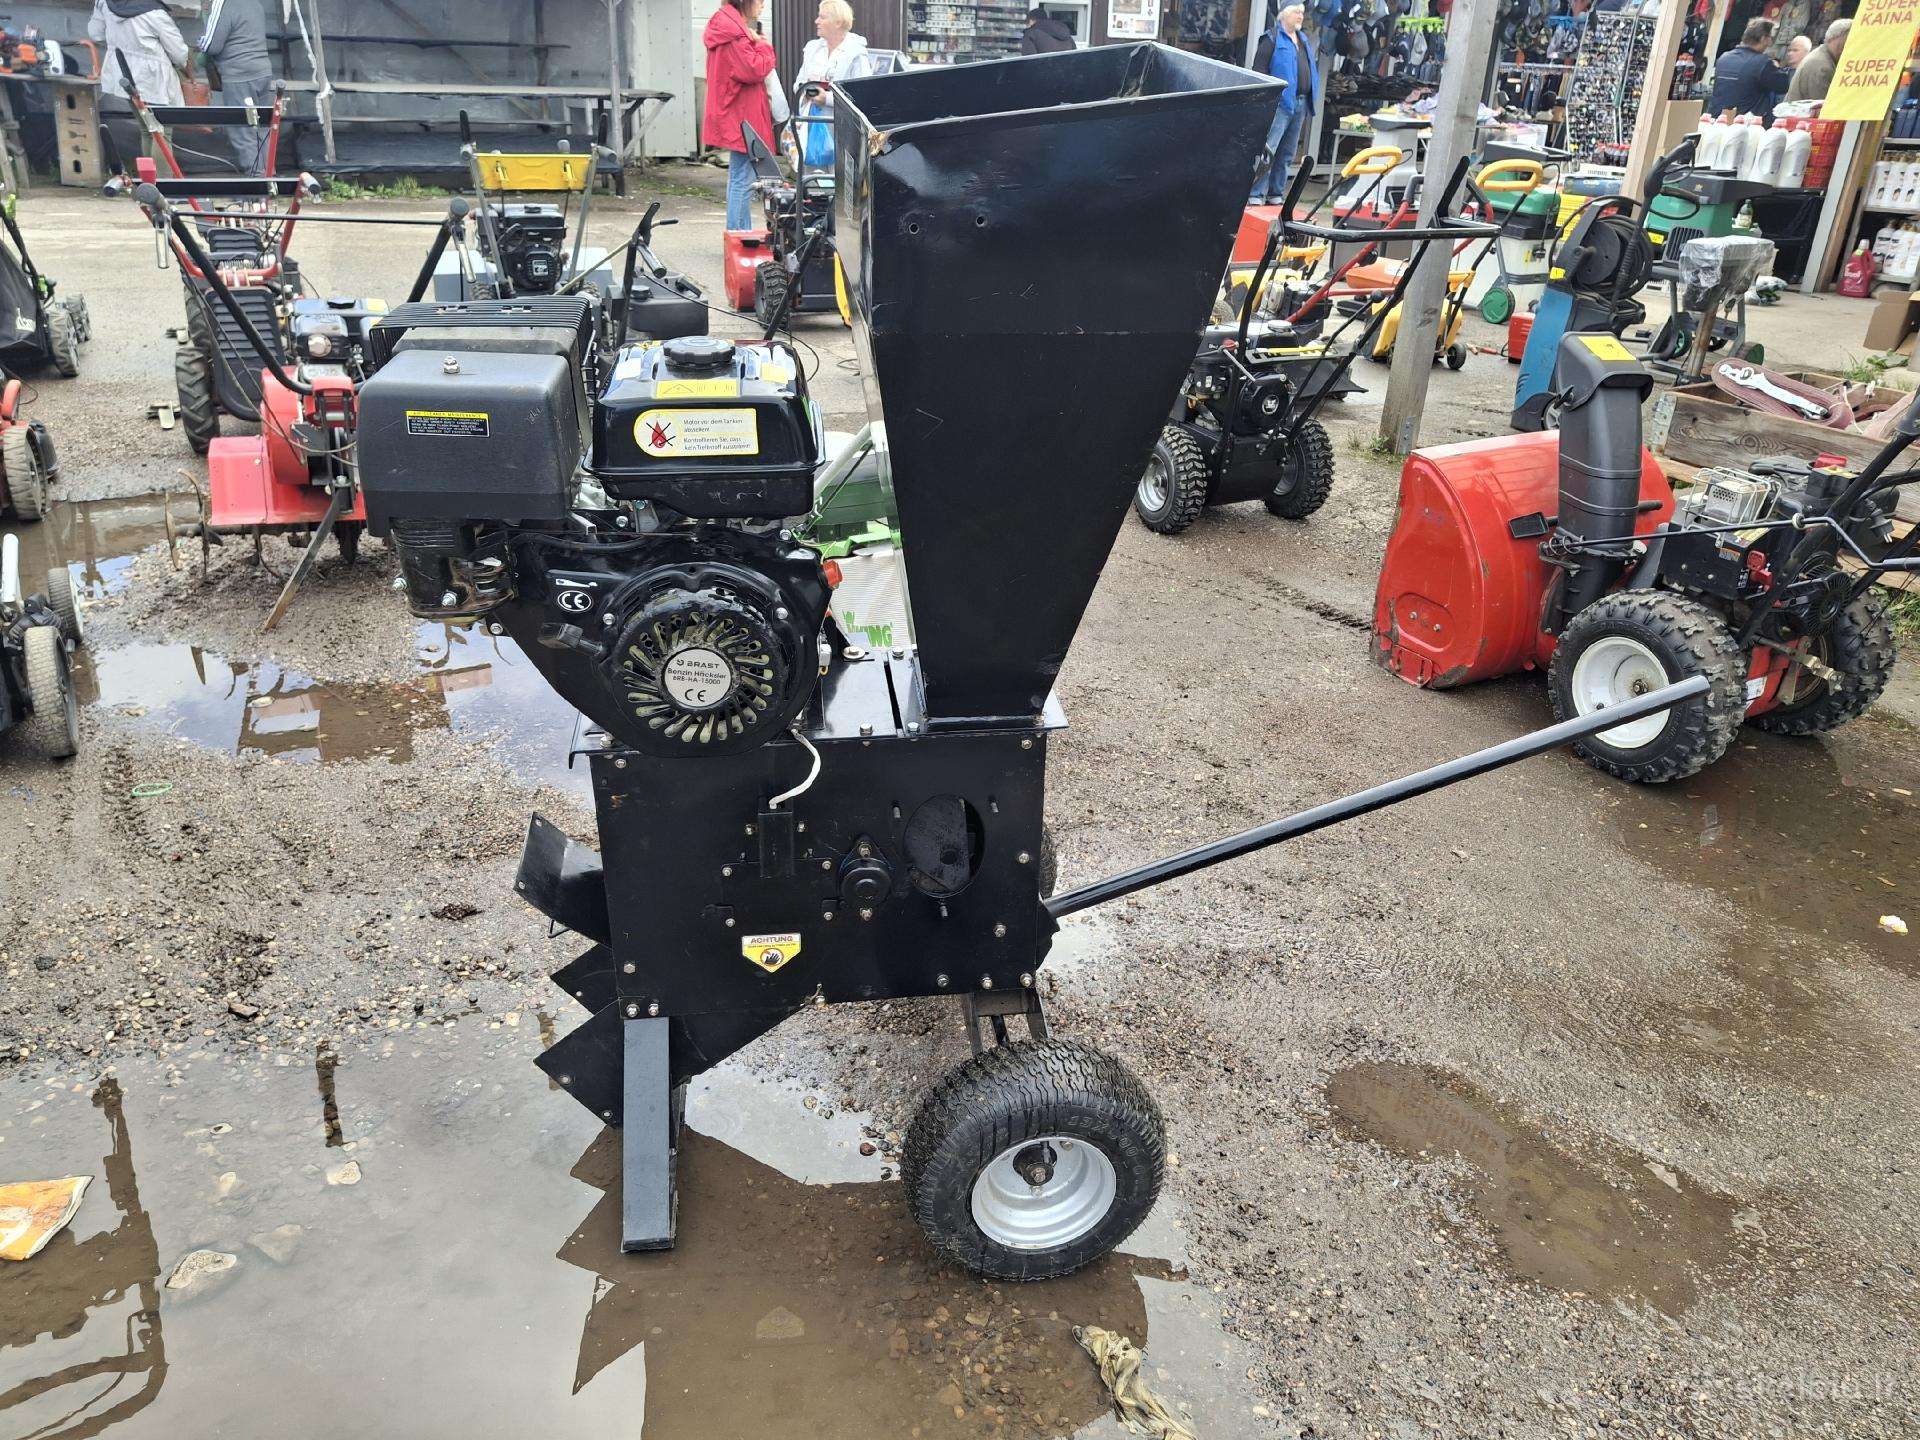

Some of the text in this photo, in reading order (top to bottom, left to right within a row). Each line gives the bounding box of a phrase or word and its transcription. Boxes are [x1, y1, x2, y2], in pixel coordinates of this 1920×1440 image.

[1866, 0, 1918, 10] SUPER
[1860, 10, 1913, 26] KAINA
[1844, 59, 1897, 72] SUPER
[1839, 74, 1889, 87] KAINA
[562, 593, 584, 609] CE
[687, 660, 720, 669] BRAST
[667, 667, 693, 677] Benzin
[684, 688, 707, 703] CE
[751, 935, 794, 944] ACHTUNG
